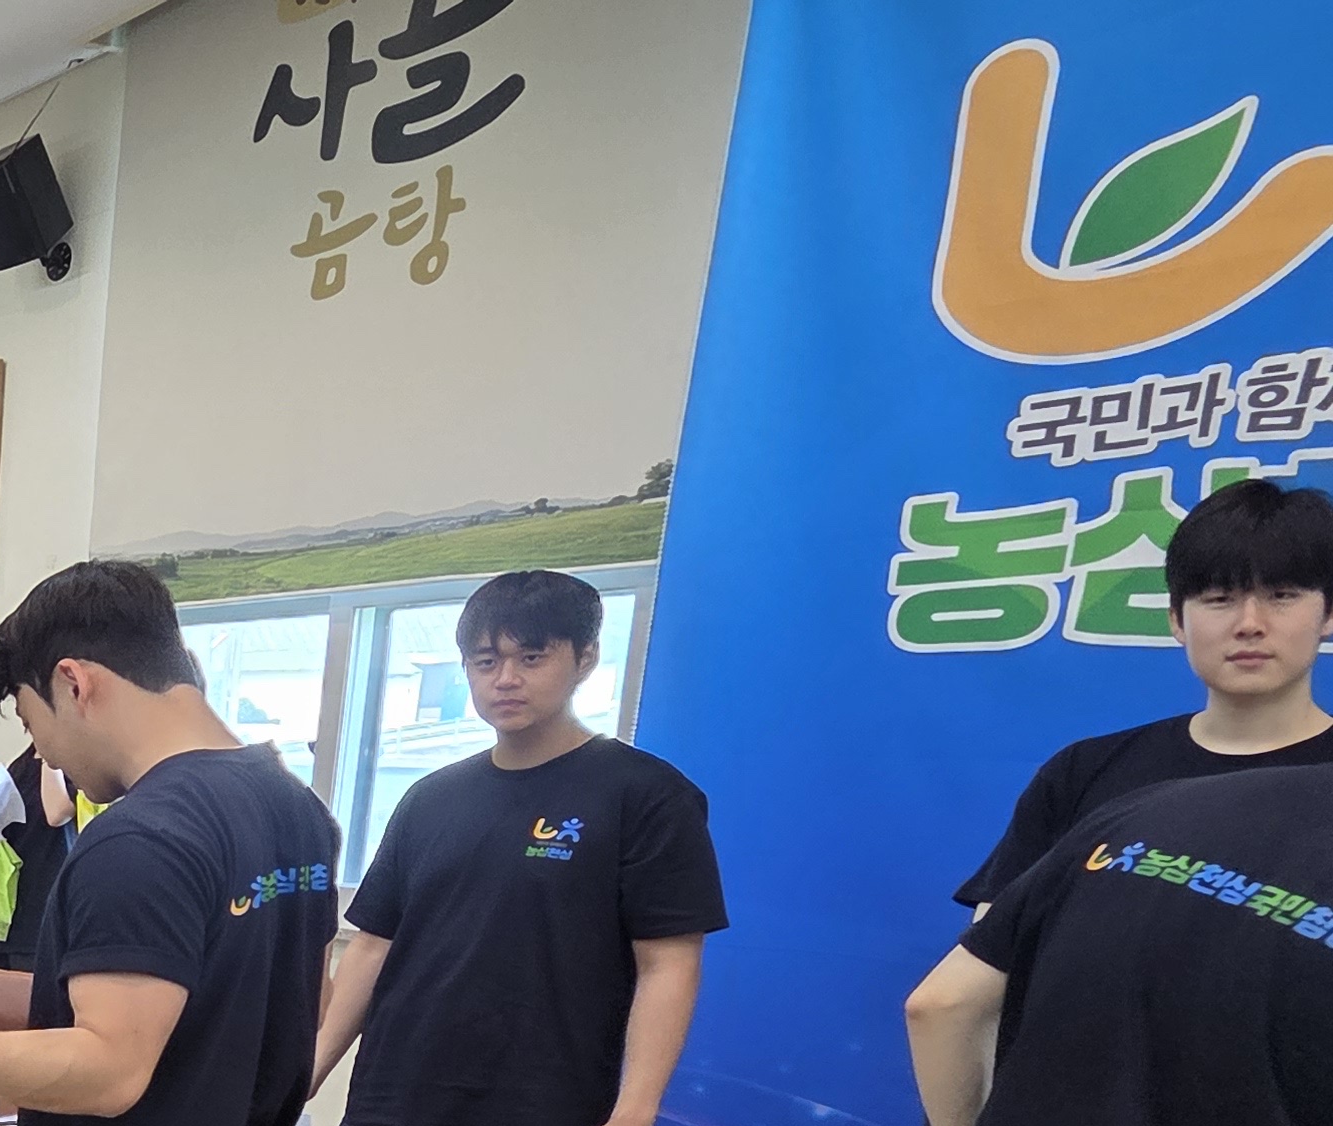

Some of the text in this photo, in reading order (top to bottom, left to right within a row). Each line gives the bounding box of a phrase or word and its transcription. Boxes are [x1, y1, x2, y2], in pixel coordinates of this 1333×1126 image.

[289, 163, 467, 301] 곰탕
[1013, 368, 1230, 461] 국민과
[1134, 849, 1333, 950] 농심천심국민참
